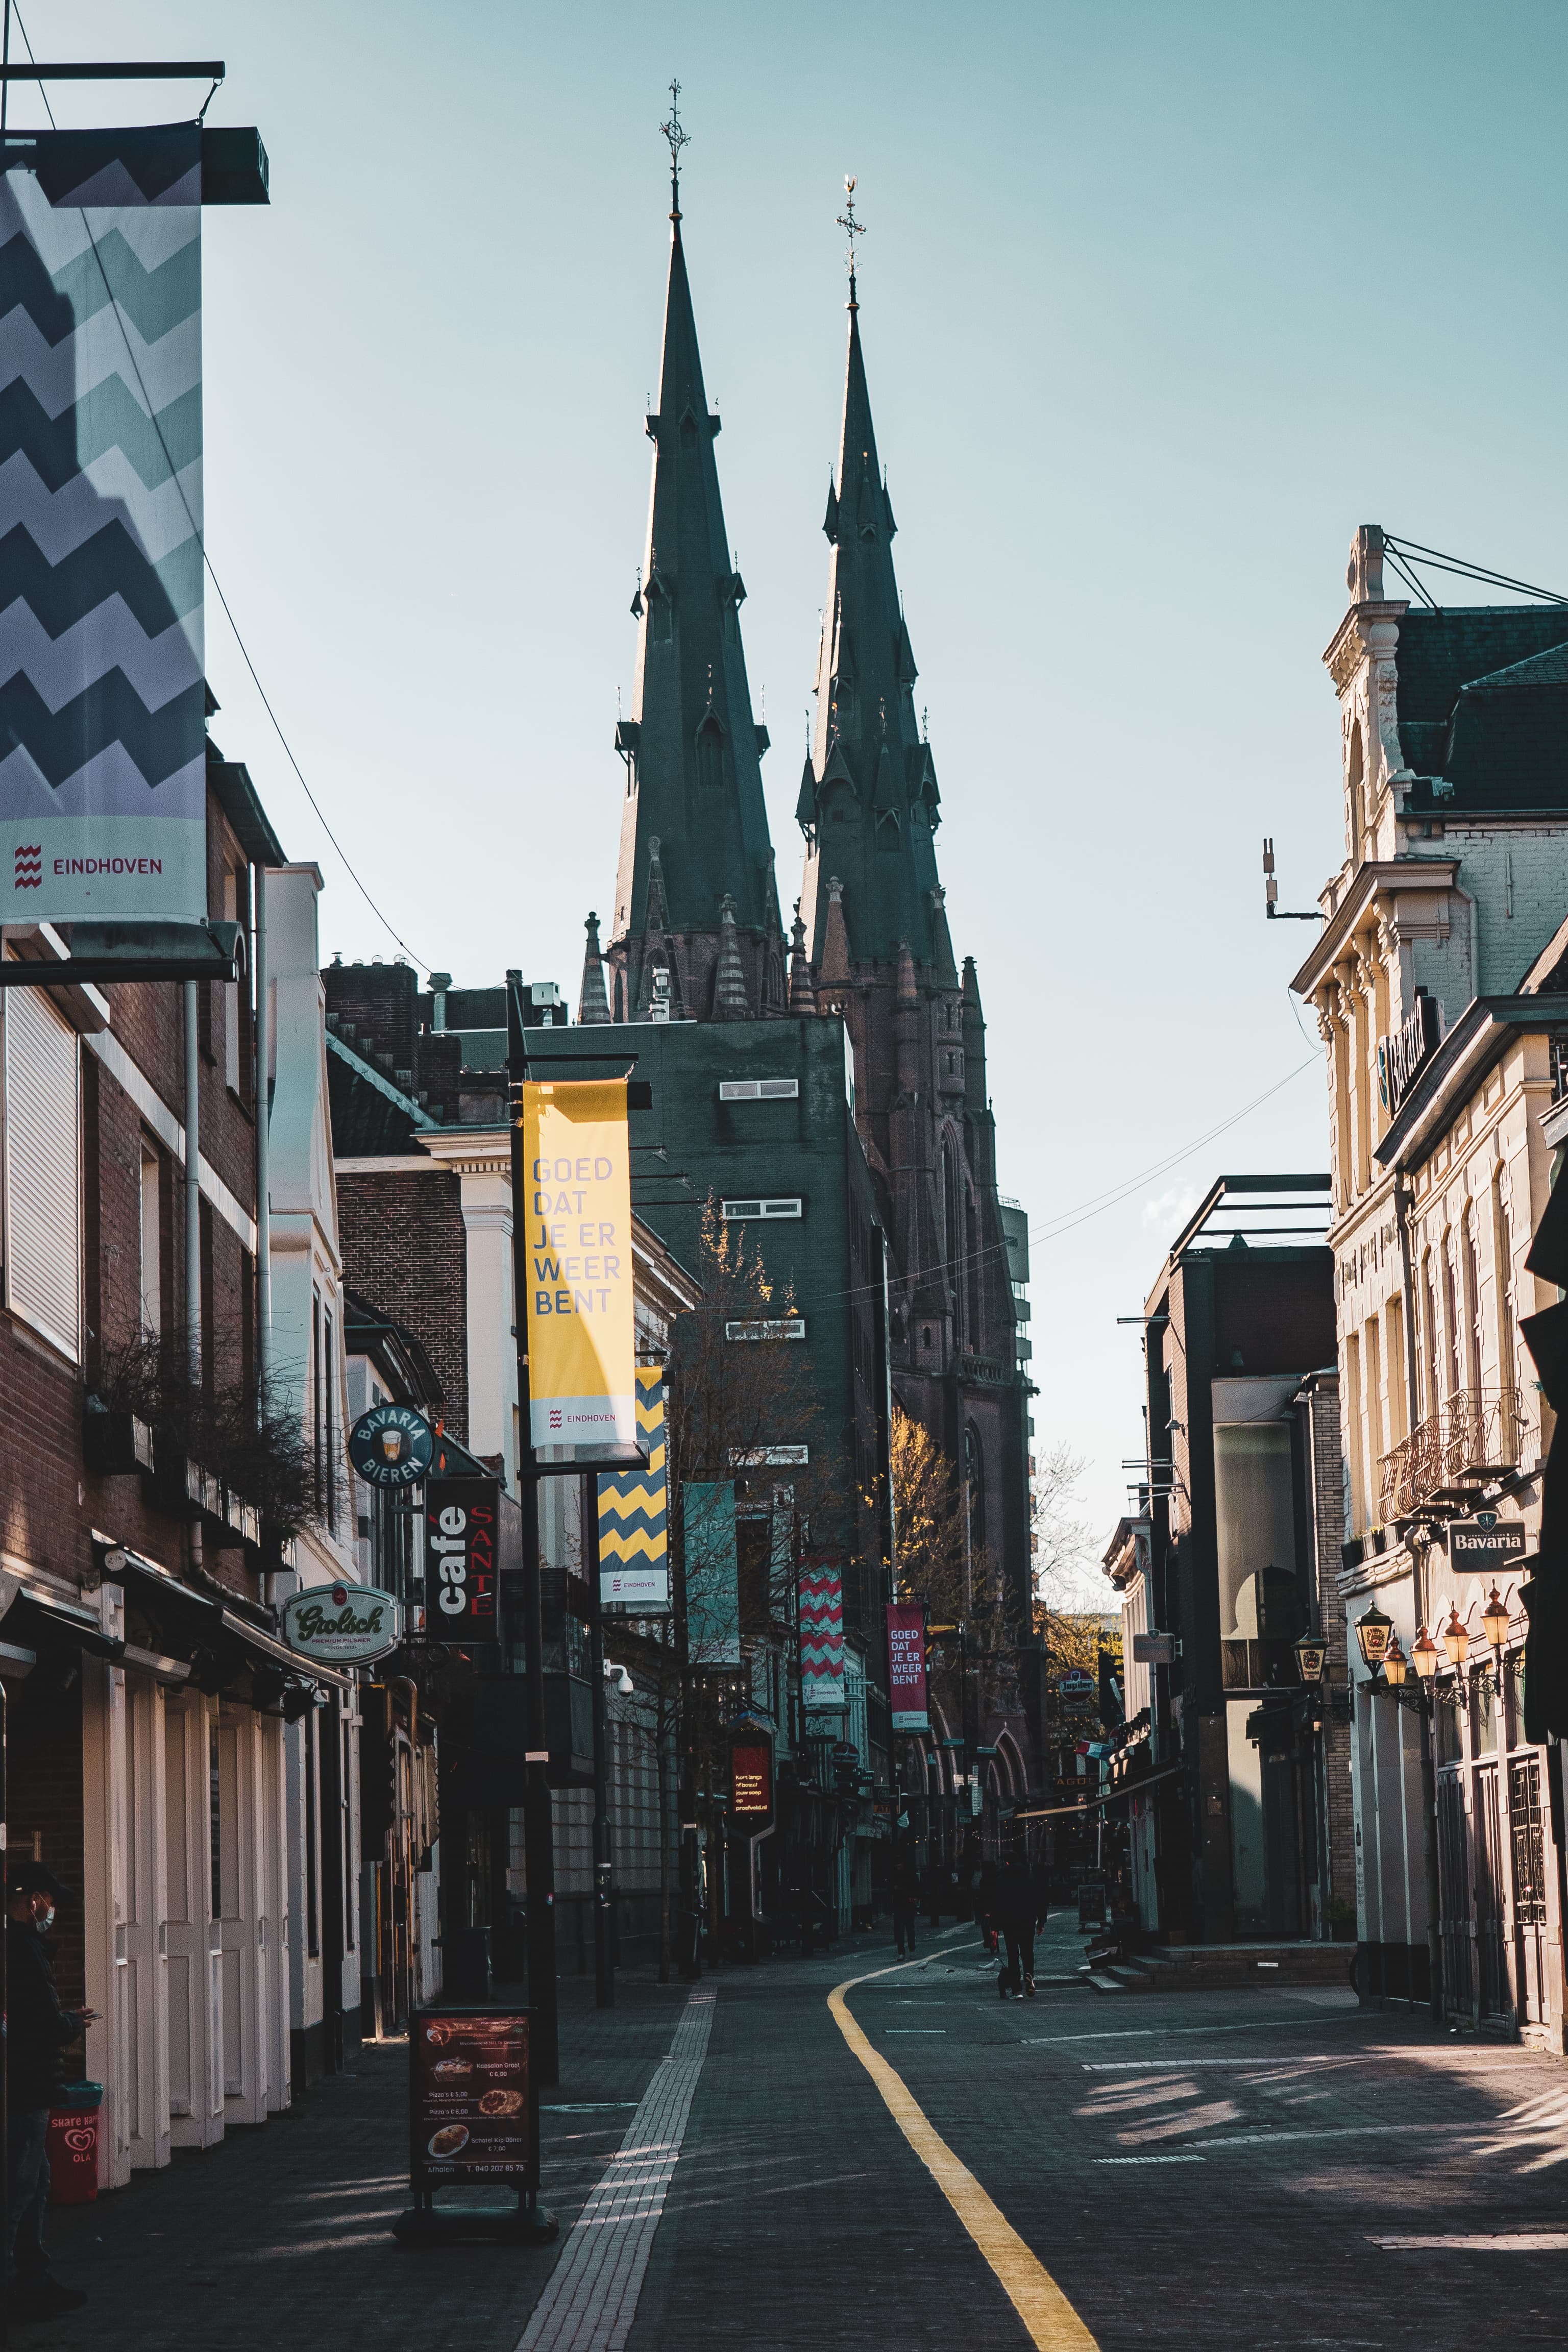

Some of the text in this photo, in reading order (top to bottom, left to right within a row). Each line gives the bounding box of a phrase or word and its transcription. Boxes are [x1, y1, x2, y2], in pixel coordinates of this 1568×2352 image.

[53, 857, 163, 875] EINDHOVEN
[533, 1157, 613, 1183] GOED
[533, 1190, 587, 1216] DAT
[533, 1222, 616, 1250] JE ER
[534, 1255, 621, 1282] WEER
[535, 1288, 612, 1315] BENT
[357, 1410, 426, 1441] BAVARIA
[567, 1413, 616, 1423] EINDHOVEN
[362, 1456, 424, 1483] BIEREN
[1455, 1534, 1522, 1550] Bavaria
[428, 1506, 467, 1614] café
[469, 1506, 494, 1615] SANTÉ
[296, 1605, 383, 1641] Grolsch
[891, 1630, 918, 1639] GOED
[891, 1641, 910, 1651] DAT
[892, 1652, 920, 1662] JE ER
[892, 1663, 922, 1673] WEER
[893, 1675, 919, 1684] BENT
[1062, 1681, 1092, 1690] Jupiler
[73, 2153, 91, 2163] OLA
